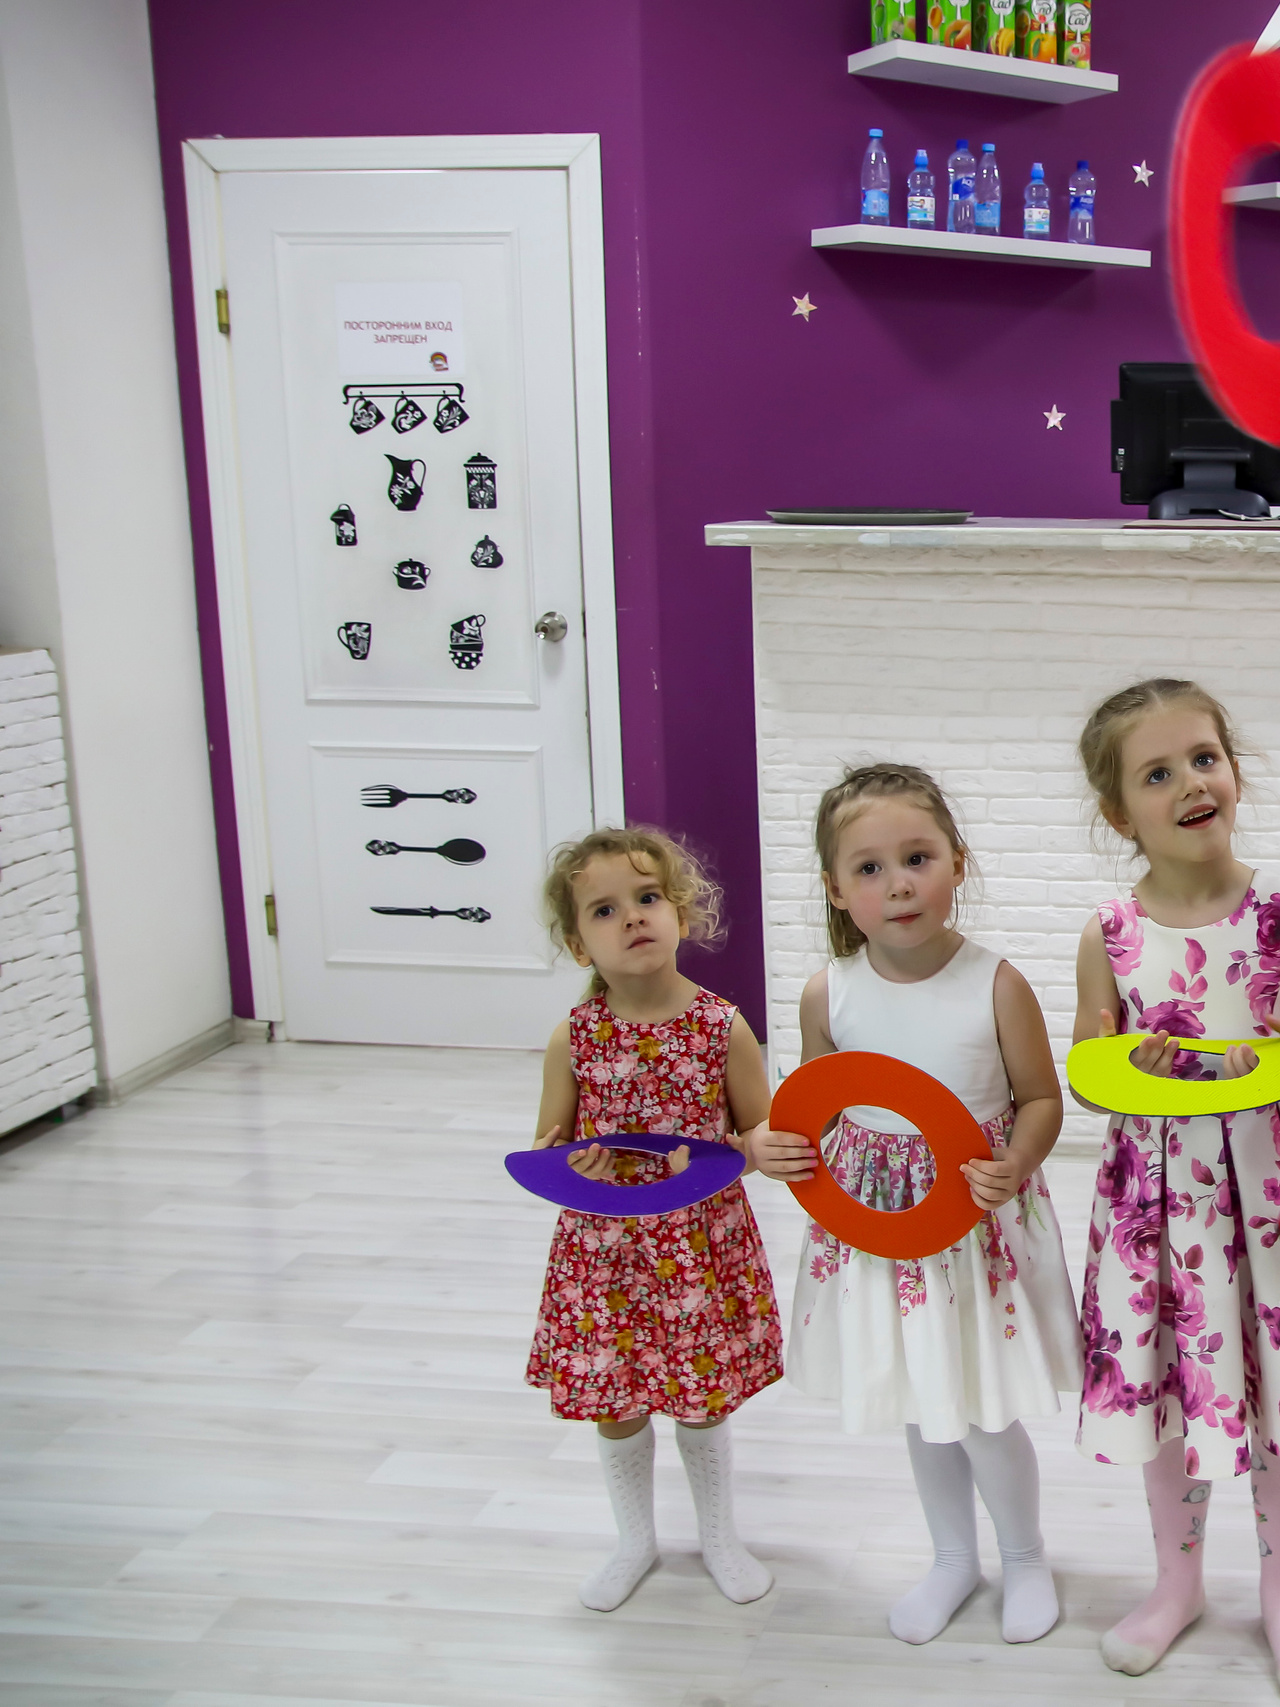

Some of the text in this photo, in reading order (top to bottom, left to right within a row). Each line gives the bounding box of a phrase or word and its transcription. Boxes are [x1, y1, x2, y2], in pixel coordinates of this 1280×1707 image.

[344, 321, 453, 332] ПОСТОРОННИМ ВХОД
[373, 334, 428, 345] ЗАПРЕЩЕН
